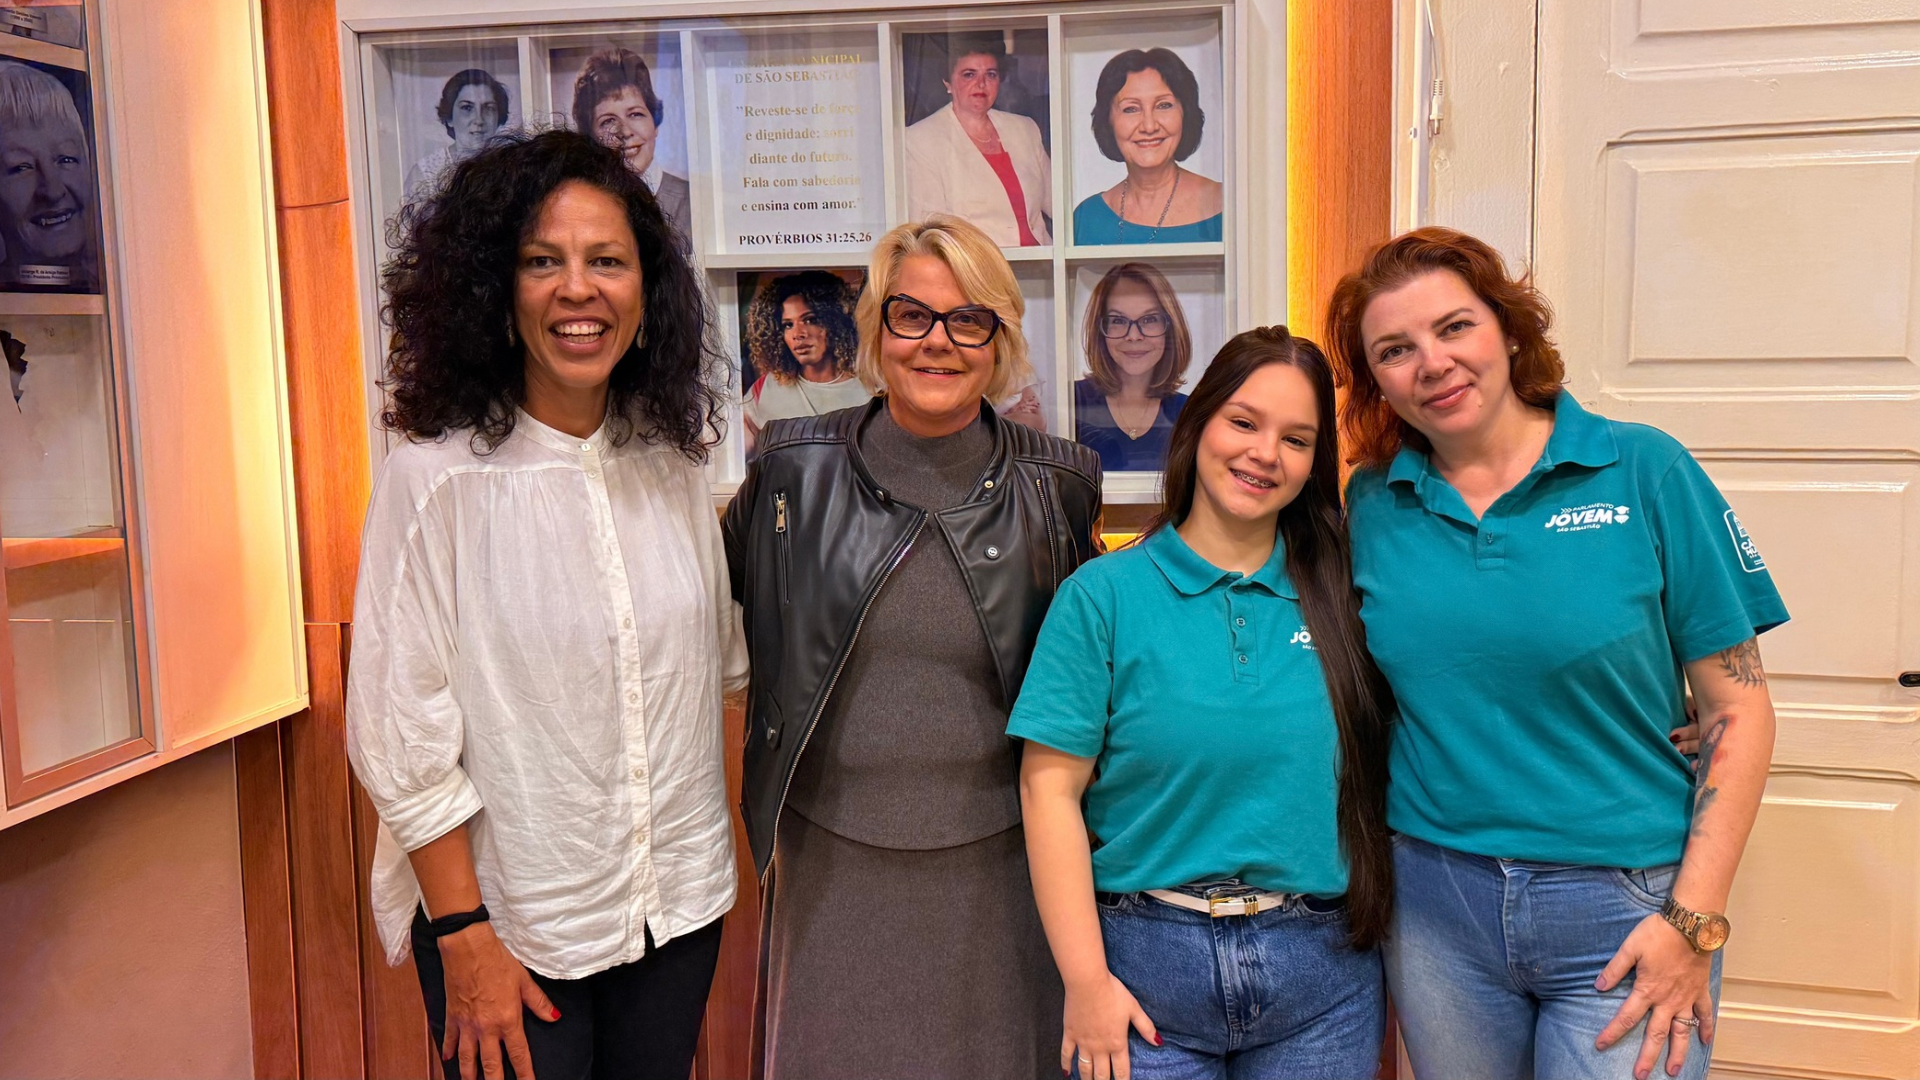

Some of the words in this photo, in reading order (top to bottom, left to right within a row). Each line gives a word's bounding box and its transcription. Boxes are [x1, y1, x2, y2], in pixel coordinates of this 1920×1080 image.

[735, 73, 752, 84] DE
[755, 69, 782, 83] SÃO
[811, 103, 825, 114] de
[745, 132, 752, 141] e
[749, 152, 788, 165] diante
[791, 151, 806, 163] do
[810, 151, 852, 163] futuro.
[743, 176, 769, 188] Fala
[773, 178, 798, 188] com
[801, 174, 860, 187] sabedoria
[741, 203, 748, 212] e
[751, 199, 790, 212] ensina
[793, 201, 818, 211] com
[739, 232, 823, 246] PROVÉRBIOS
[825, 231, 872, 244] 31:25,26
[1573, 502, 1614, 511] PARLAMENTO
[1545, 508, 1613, 528] JOVEM
[1290, 631, 1311, 644] JO
